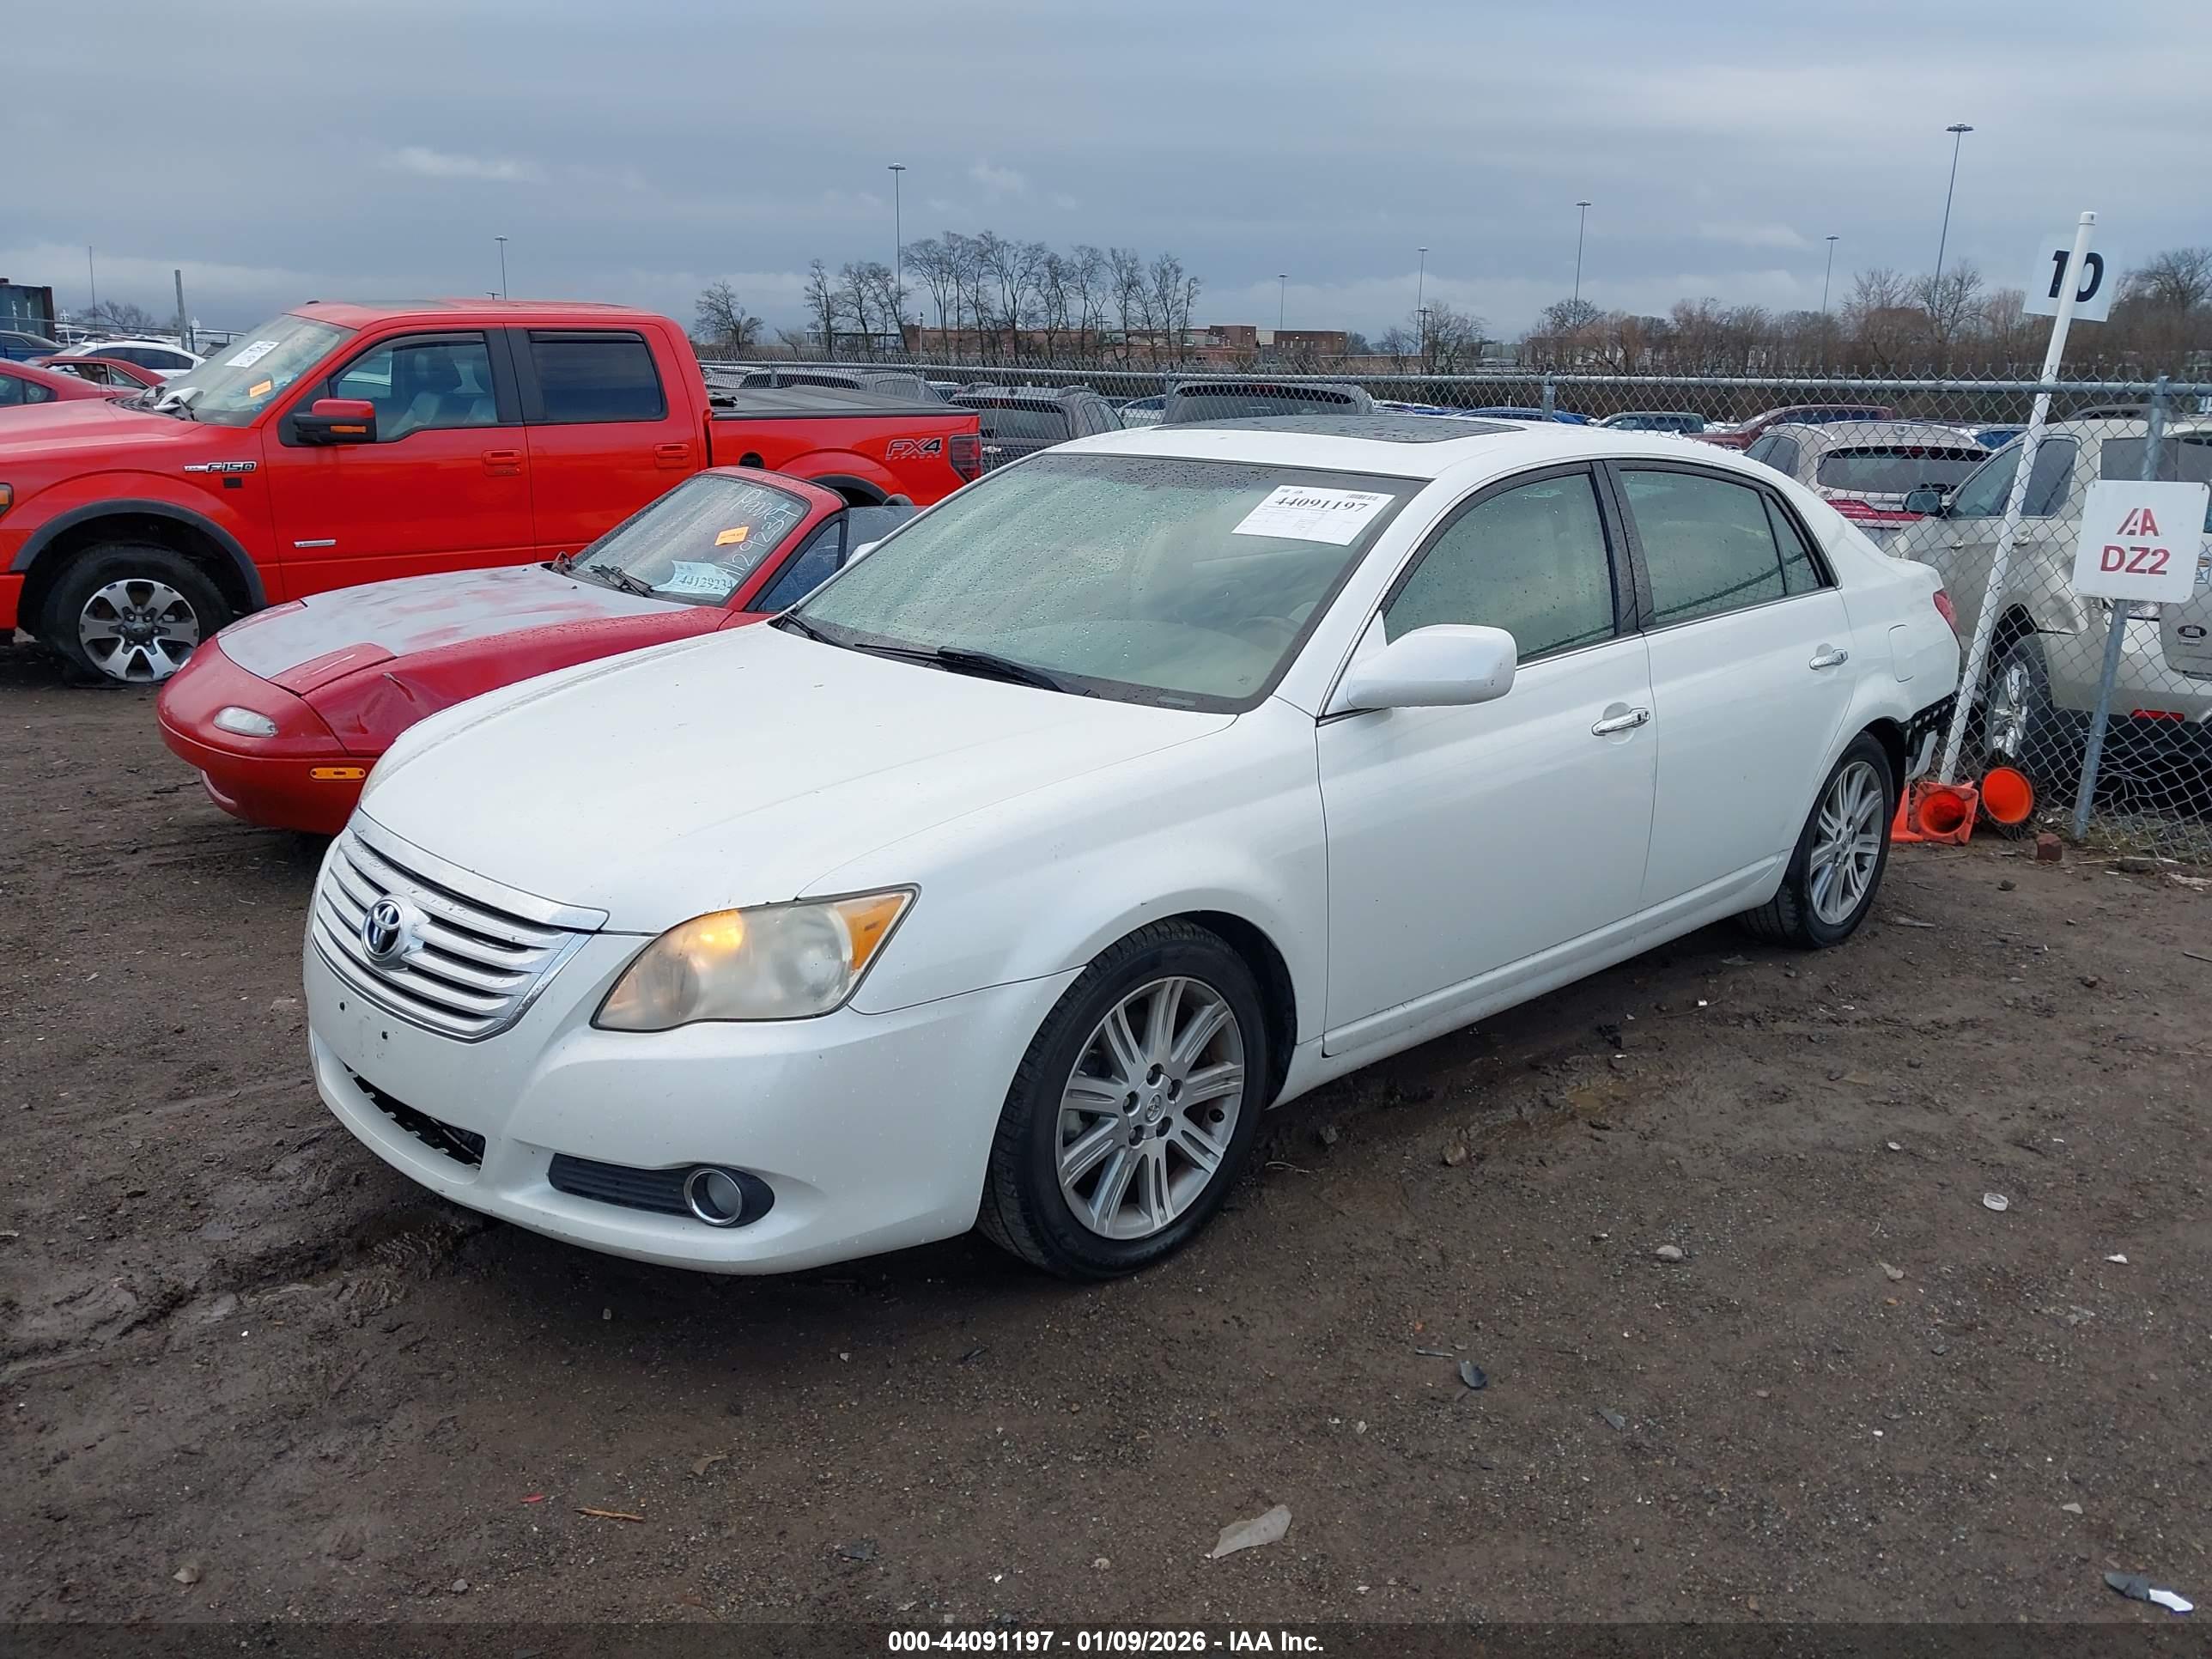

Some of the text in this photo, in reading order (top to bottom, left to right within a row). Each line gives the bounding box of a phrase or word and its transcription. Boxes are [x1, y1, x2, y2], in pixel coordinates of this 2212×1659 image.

[2048, 250, 2104, 302] 10
[885, 437, 943, 456] FX4
[1274, 496, 1370, 513] 44091197
[2100, 545, 2171, 575] DZ2
